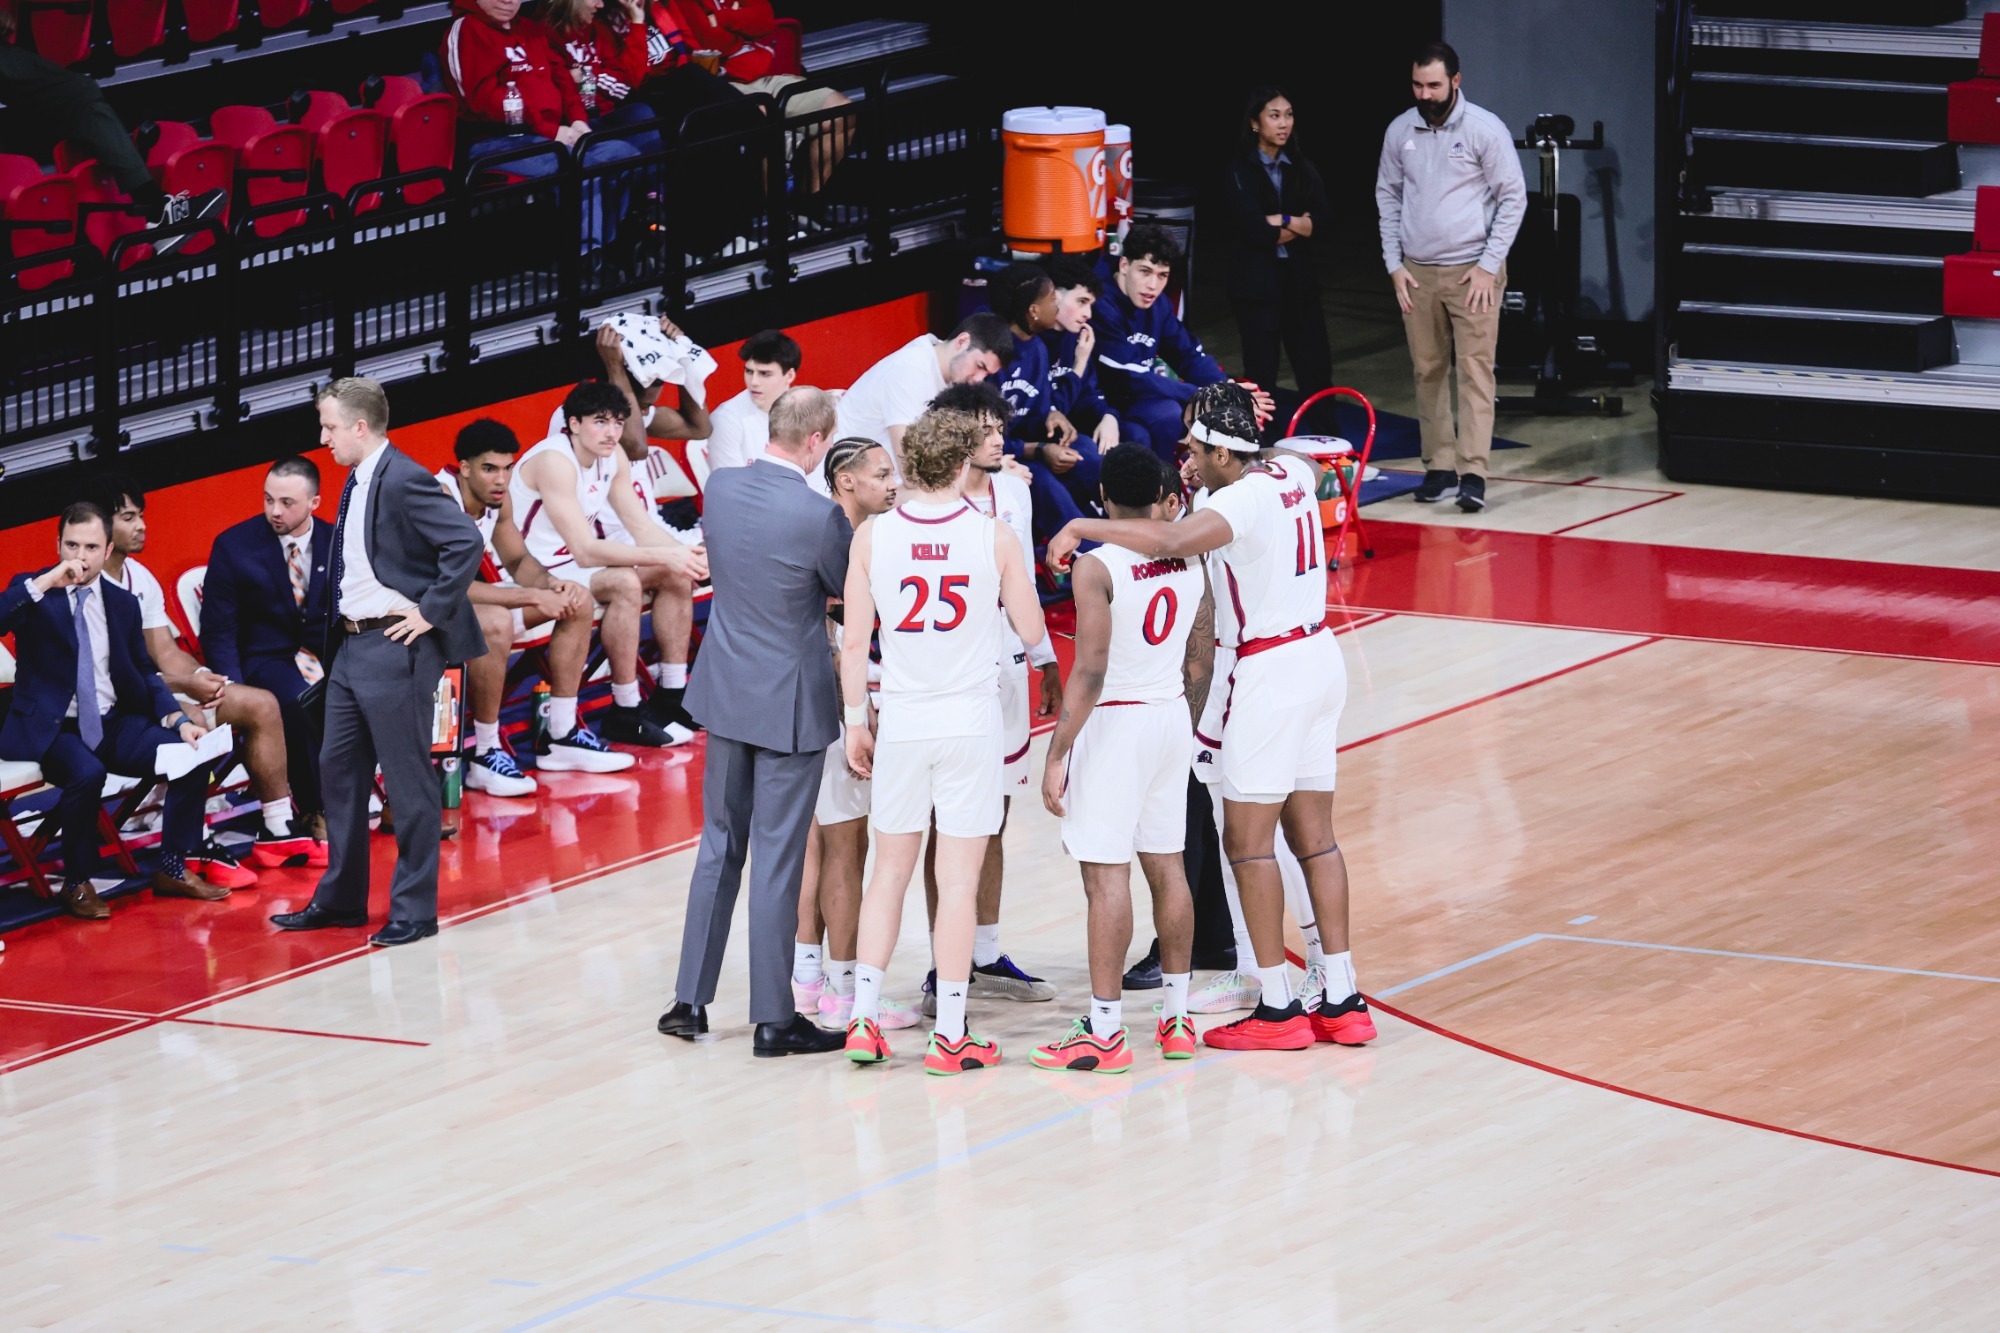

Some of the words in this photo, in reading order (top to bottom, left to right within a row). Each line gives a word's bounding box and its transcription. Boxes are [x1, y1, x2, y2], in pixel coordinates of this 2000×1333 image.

[1092, 150, 1107, 186] G
[1119, 149, 1133, 179] G
[1334, 500, 1348, 523] G
[911, 543, 950, 561] KELLY
[1294, 510, 1319, 577] 11
[1131, 557, 1187, 581] ROBINSON
[893, 574, 970, 633] 25
[1142, 586, 1178, 646] 0
